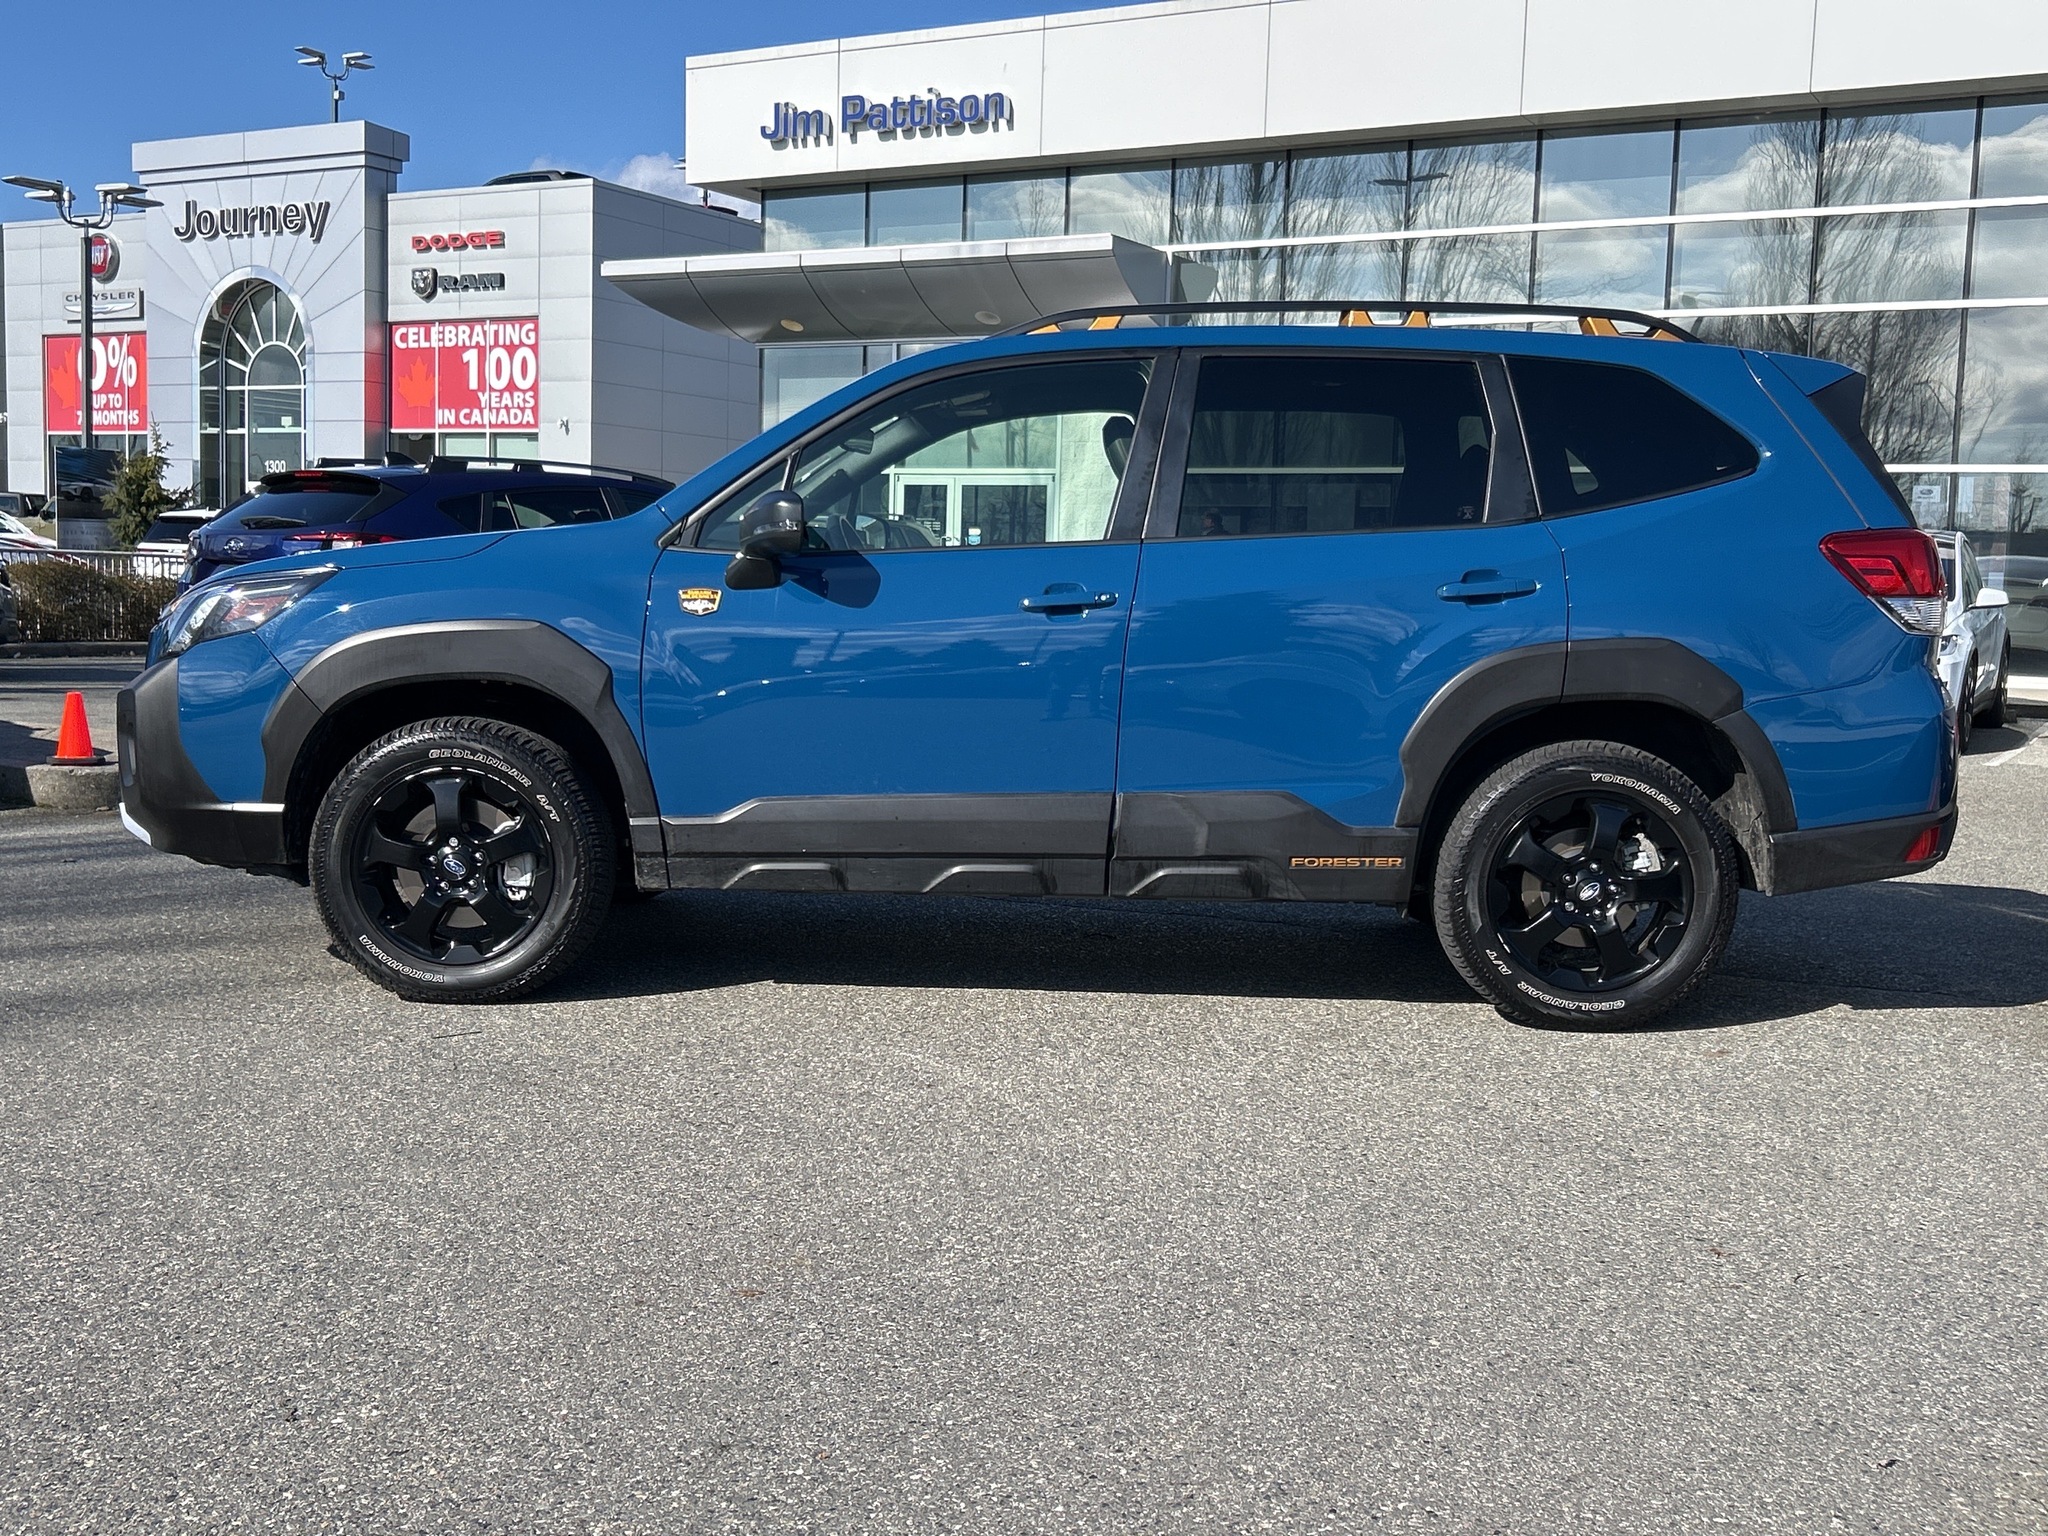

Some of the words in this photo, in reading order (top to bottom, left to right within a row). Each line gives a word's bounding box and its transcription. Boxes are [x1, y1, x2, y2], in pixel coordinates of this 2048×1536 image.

[760, 102, 830, 141] Jim
[841, 88, 1008, 134] Pattison
[174, 200, 329, 241] Journey
[411, 231, 504, 250] DODGE
[437, 273, 504, 290] RAM
[65, 291, 136, 303] CHYSLER
[394, 323, 536, 349] CELEBRATING
[78, 333, 138, 391] 0%
[462, 346, 537, 390] 100
[92, 393, 107, 409] UP
[107, 393, 122, 409] TO
[478, 392, 535, 408] YEARS
[92, 410, 140, 426] MONTHS
[438, 410, 455, 425] IN
[459, 408, 535, 425] CANADA
[264, 459, 287, 473] 1300
[429, 749, 532, 788] GEOLANDAR
[536, 794, 561, 823] A/T
[1590, 773, 1682, 815] YOKOHAMA
[1290, 856, 1403, 868] FORESTER
[359, 934, 446, 983] YOKOHAMA
[1485, 949, 1513, 976] A/T
[1517, 981, 1626, 1012] GEOLANDAR
